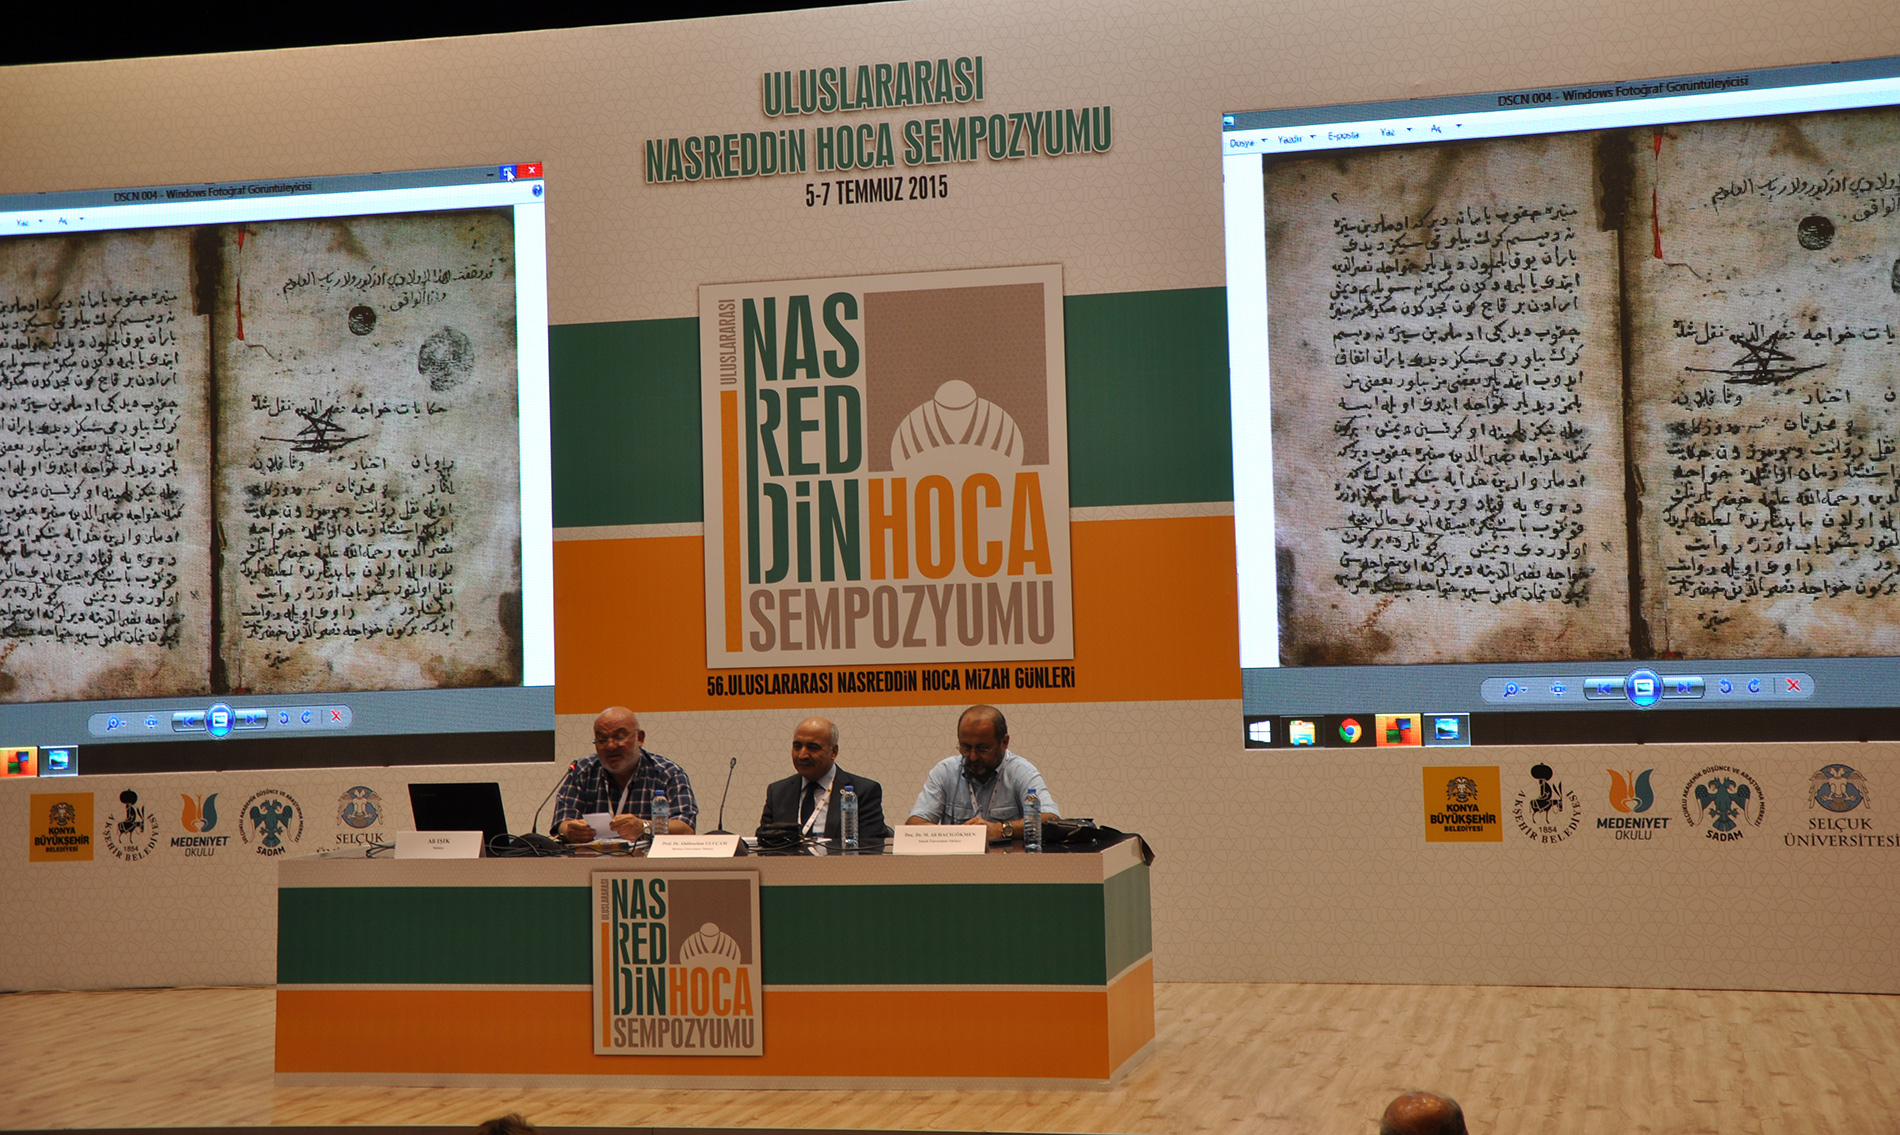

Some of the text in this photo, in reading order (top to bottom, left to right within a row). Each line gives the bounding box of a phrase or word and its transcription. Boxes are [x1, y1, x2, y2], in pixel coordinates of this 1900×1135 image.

[763, 56, 984, 116] ULUSLARARASI
[1498, 93, 1530, 107] DSCN
[1531, 92, 1552, 105] 004
[1563, 88, 1613, 102] Windows
[1615, 83, 1664, 99] Fotoğraf
[816, 122, 895, 171] HOCA
[904, 106, 1112, 165] SEMPOZYUMU
[114, 191, 141, 202] DSCN
[141, 190, 157, 201] 004
[166, 187, 206, 200] Windows
[208, 185, 246, 199] Fotoğraf
[806, 174, 948, 207] 5-7 TEMMUZ 2015
[718, 299, 737, 385] ULUSLARARASI
[742, 292, 860, 381] NAS
[746, 385, 862, 477] RED
[868, 472, 1053, 581] HOCA
[749, 580, 1055, 652] SEMPOZYUMU
[707, 672, 833, 696] 56.ULUSLARARASI
[922, 668, 960, 691] HOCA
[1732, 767, 1741, 775] VE
[1430, 812, 1496, 825] BÜYÜKŞEHİR
[1446, 804, 1480, 813] KONYA
[49, 827, 76, 835] KONYA
[1615, 830, 1652, 840] OKULU
[1706, 830, 1743, 842] SADAM
[1809, 817, 1873, 832] SELÇUK
[34, 834, 90, 846] BÜYÜKŞEHİR
[185, 848, 215, 857] OKULU
[256, 846, 286, 857] SADAM
[336, 833, 384, 846] SELÇUK
[612, 878, 666, 920] NAS
[613, 922, 667, 965] RED
[669, 966, 754, 1016] HOCA
[614, 1018, 754, 1048] SEMPOZYUMU
